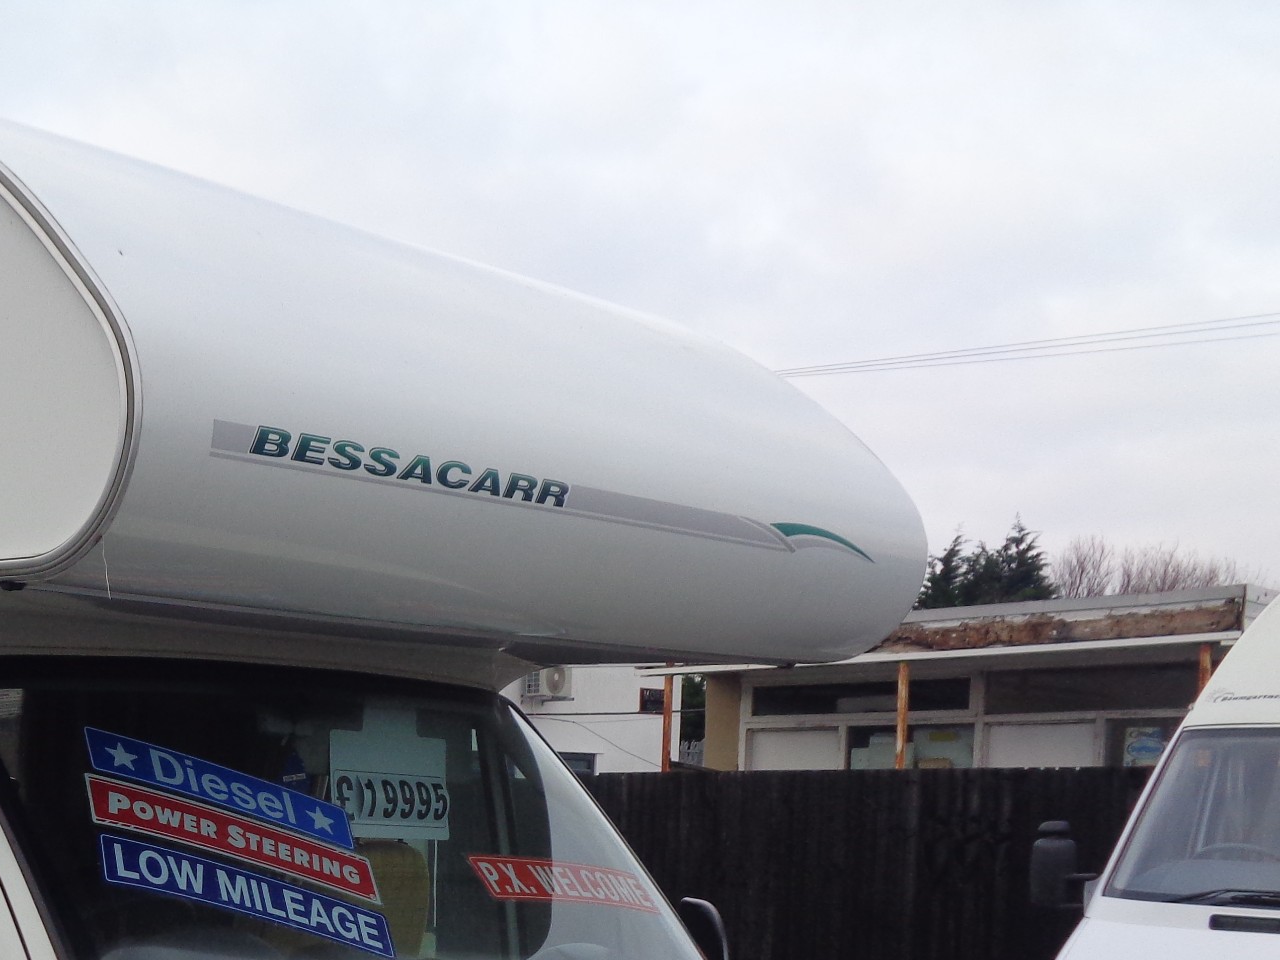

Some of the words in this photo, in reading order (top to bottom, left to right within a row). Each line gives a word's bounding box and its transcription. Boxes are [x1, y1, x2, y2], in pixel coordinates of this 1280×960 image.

[248, 425, 570, 508] BESSACARR
[149, 749, 297, 824] Diesel
[335, 775, 448, 821] £19995
[108, 791, 218, 839] POWER
[227, 825, 360, 885] STEERING
[114, 843, 204, 895] LOW
[216, 870, 383, 949] MILEAGE
[477, 861, 538, 893] P.X.
[527, 864, 653, 907] WELCOME
